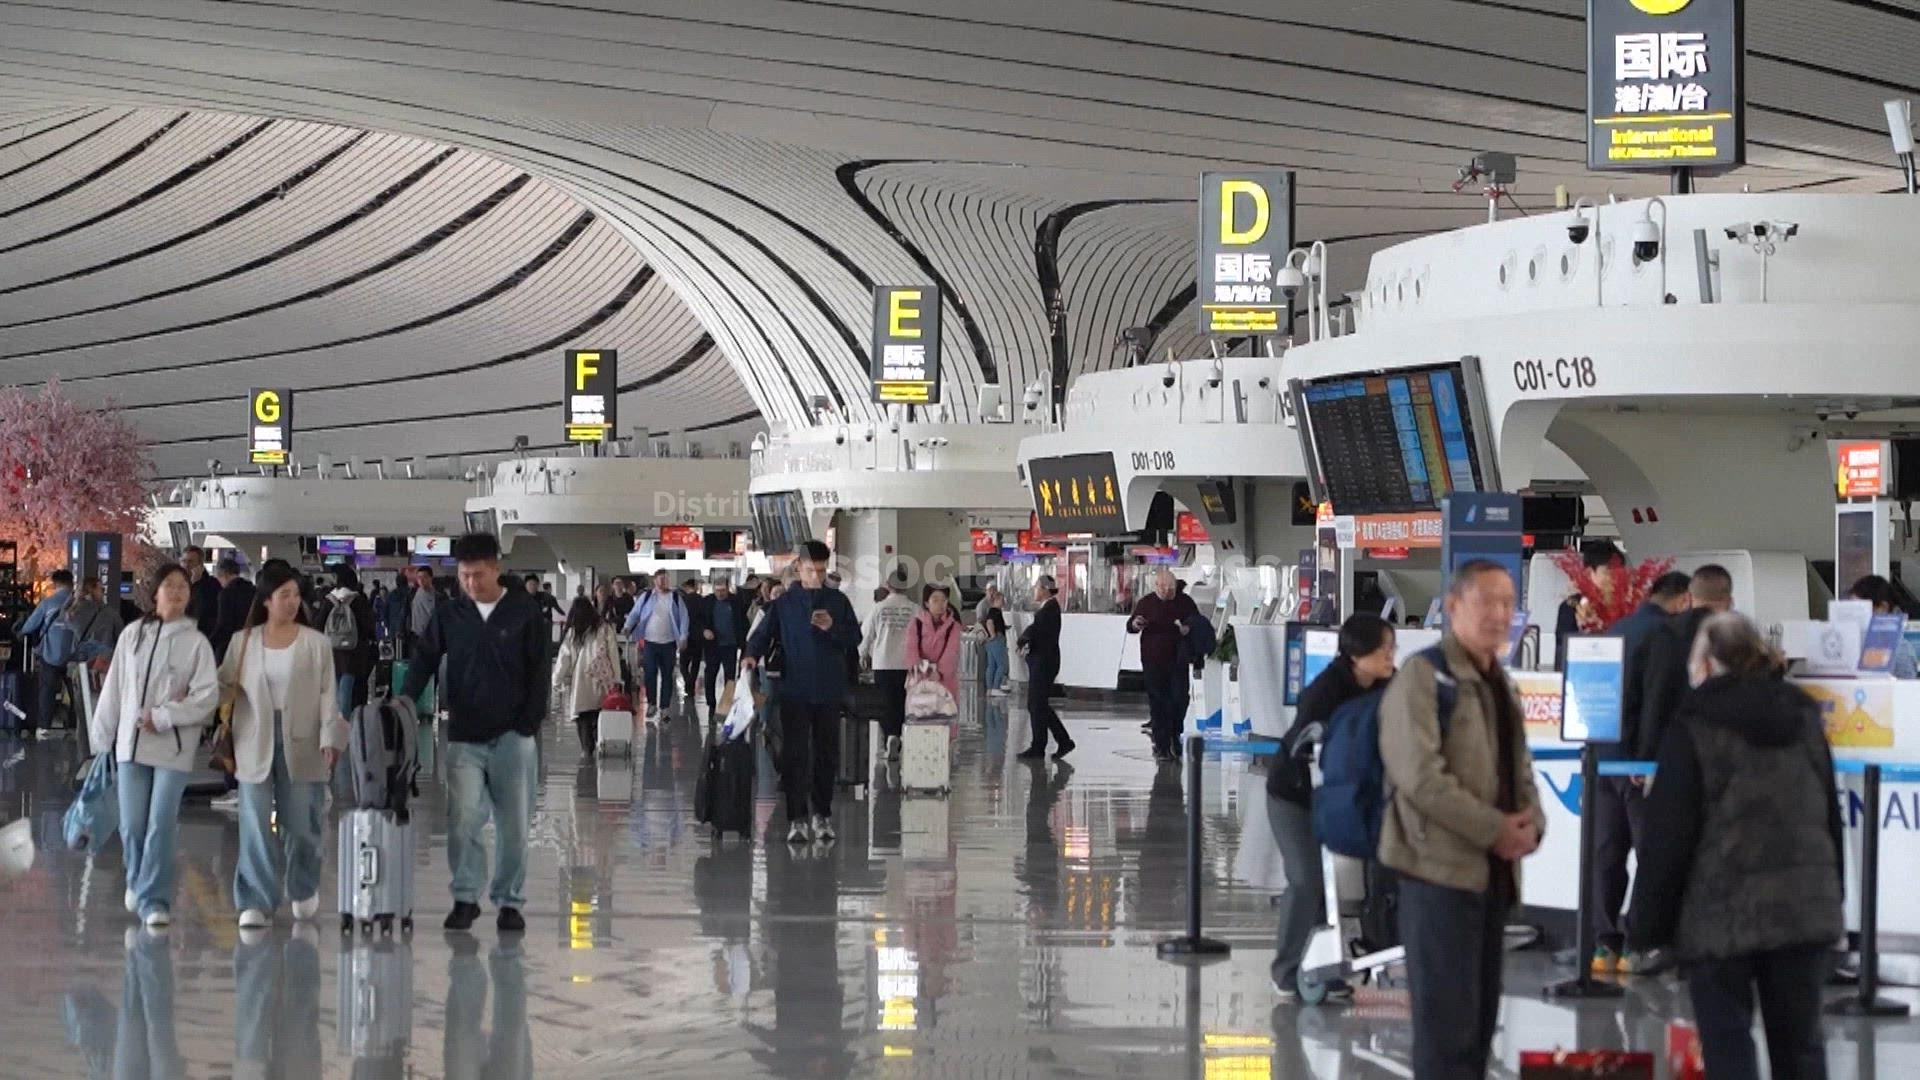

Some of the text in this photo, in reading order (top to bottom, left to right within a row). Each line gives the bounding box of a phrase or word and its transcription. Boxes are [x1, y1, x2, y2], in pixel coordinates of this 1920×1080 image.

[1615, 32, 1708, 80] 国际
[1611, 125, 1714, 145] International
[1220, 180, 1271, 245] D
[1214, 253, 1273, 283] 国际
[889, 290, 922, 337] E
[576, 352, 601, 391] F
[1513, 357, 1597, 392] C01-C18
[255, 390, 281, 423] G
[1131, 451, 1176, 471] D01-D18
